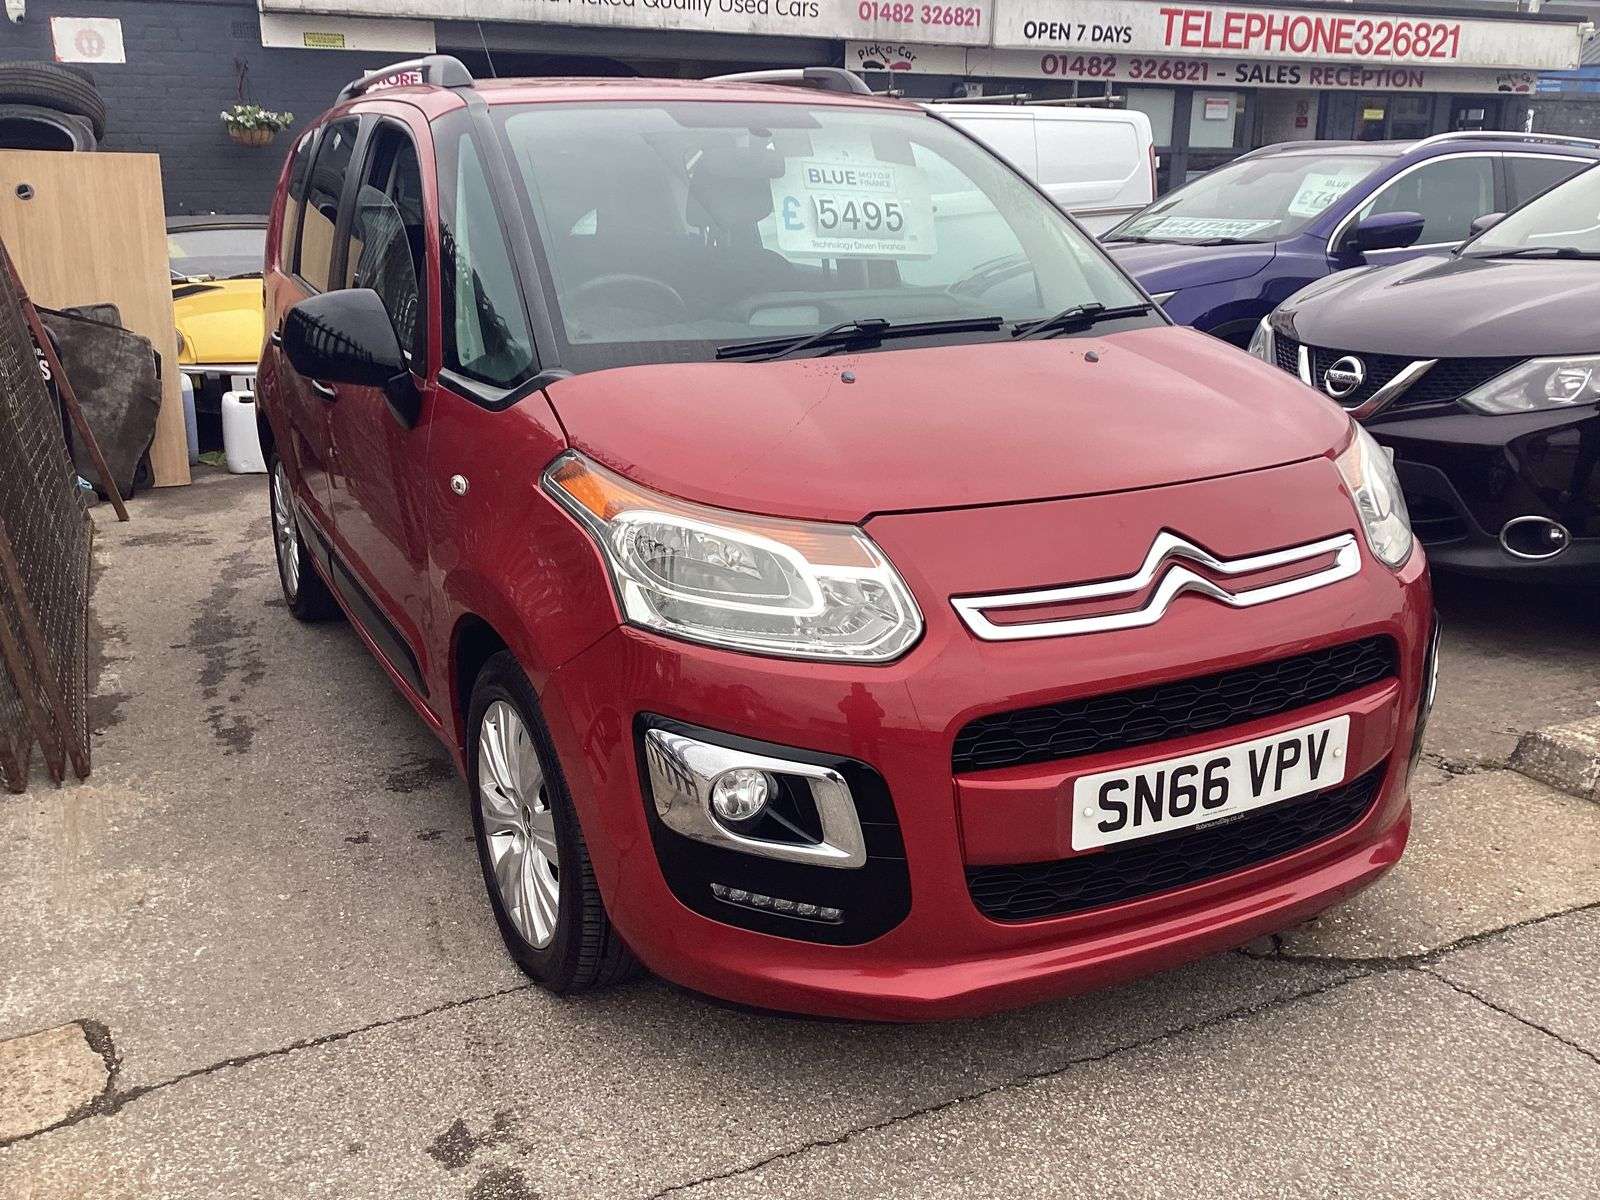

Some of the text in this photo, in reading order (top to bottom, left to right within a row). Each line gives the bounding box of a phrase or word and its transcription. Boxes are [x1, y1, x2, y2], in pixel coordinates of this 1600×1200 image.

[719, 0, 769, 15] Used
[775, 0, 820, 18] Cars
[858, 1, 981, 27] 01482 326821
[1023, 21, 1133, 44] OPEN 7 DAYS
[1159, 7, 1461, 59] TELEPHONE326821
[377, 73, 419, 86] ORE
[1040, 53, 1117, 78] 01482
[1128, 58, 1210, 82] 326821
[1234, 63, 1301, 85] SALES
[1309, 65, 1425, 88] RECEPTION
[808, 167, 857, 185] BLUE
[858, 171, 891, 180] MOTOR
[859, 179, 891, 188] FINANCE
[818, 199, 904, 233] 5495
[810, 239, 853, 251] Technology
[1097, 729, 1330, 833] SN66 VPV
